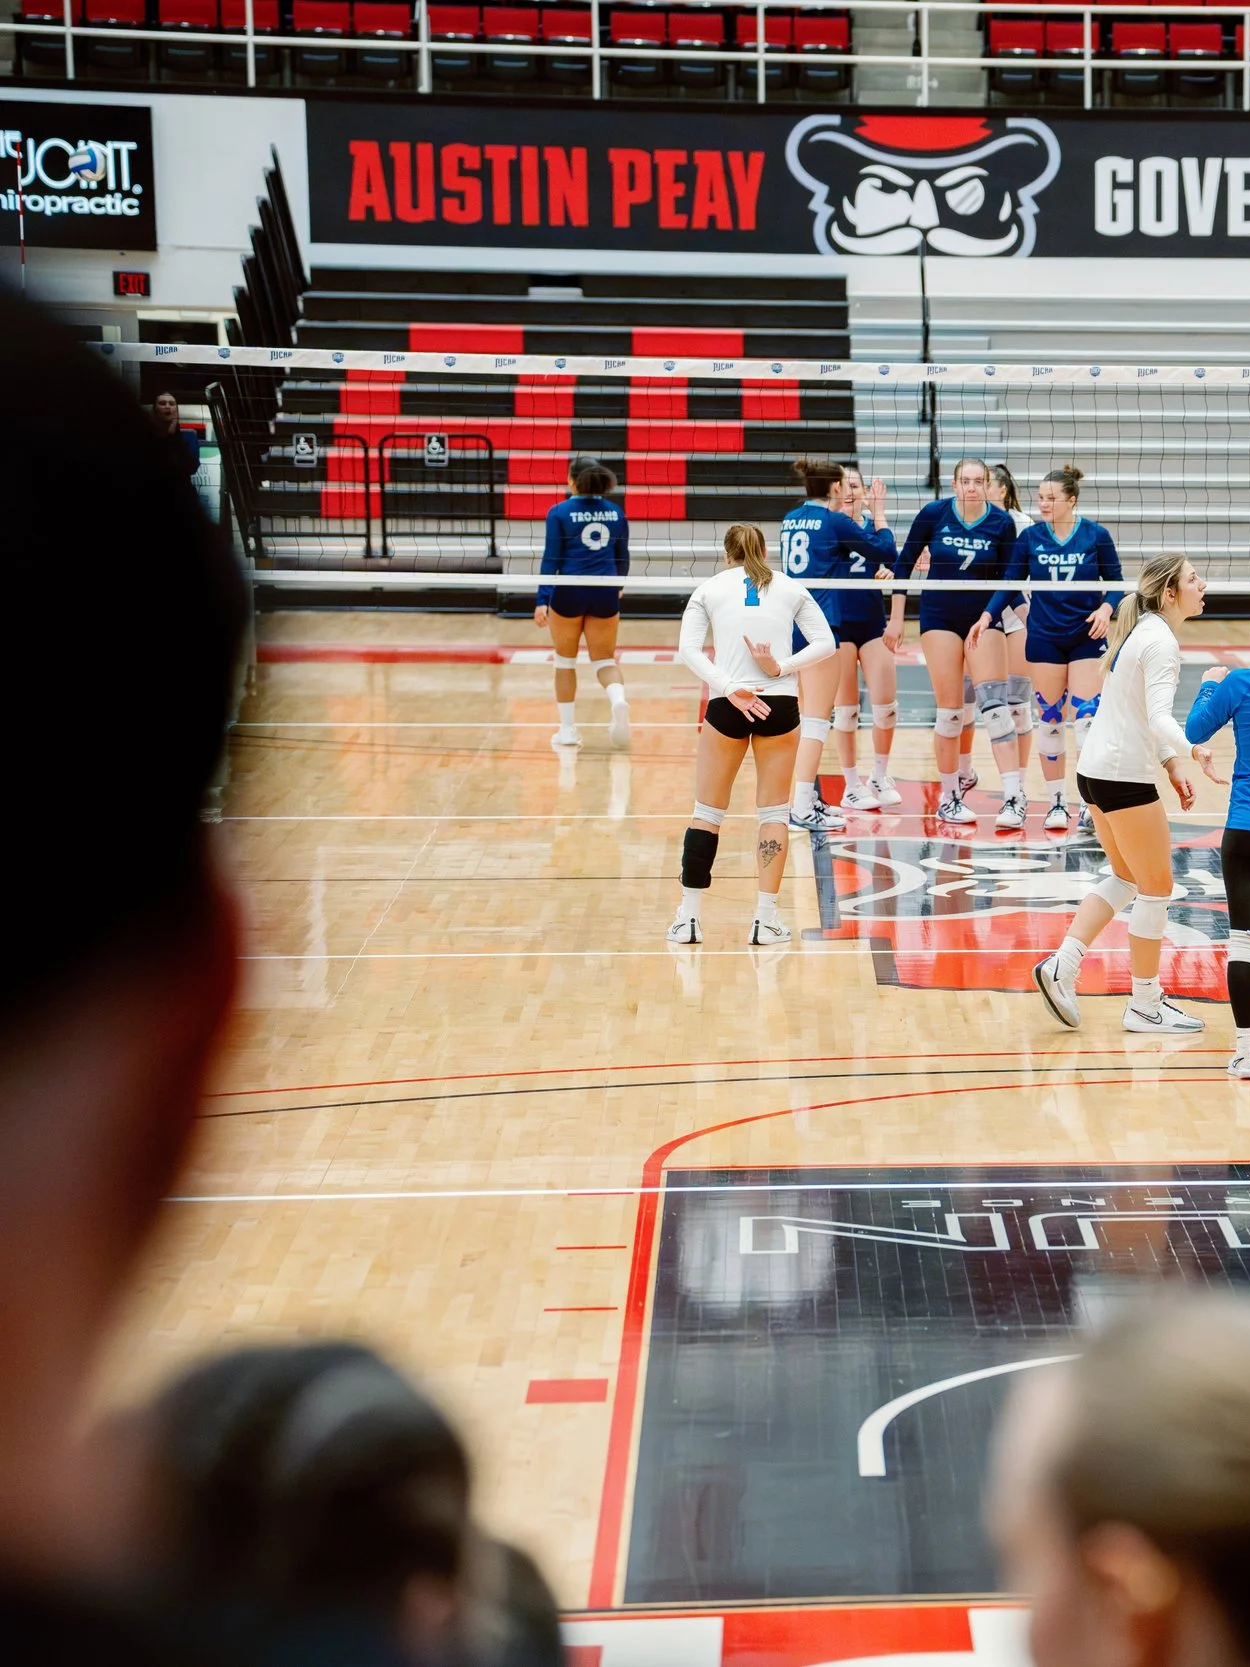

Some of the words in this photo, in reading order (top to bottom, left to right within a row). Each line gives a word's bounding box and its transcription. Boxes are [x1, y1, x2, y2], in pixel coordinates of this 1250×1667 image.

[348, 140, 589, 227] AUSTIN
[609, 149, 765, 230] PEAY
[118, 273, 145, 293] EXIT
[155, 345, 178, 355] NJCAA
[569, 511, 619, 523] TROJANS
[942, 536, 992, 551] COLBY
[781, 531, 810, 575] 18
[849, 551, 866, 572] 2
[957, 549, 976, 571] 7
[1038, 553, 1086, 565] COLBY
[1048, 566, 1076, 581] 17
